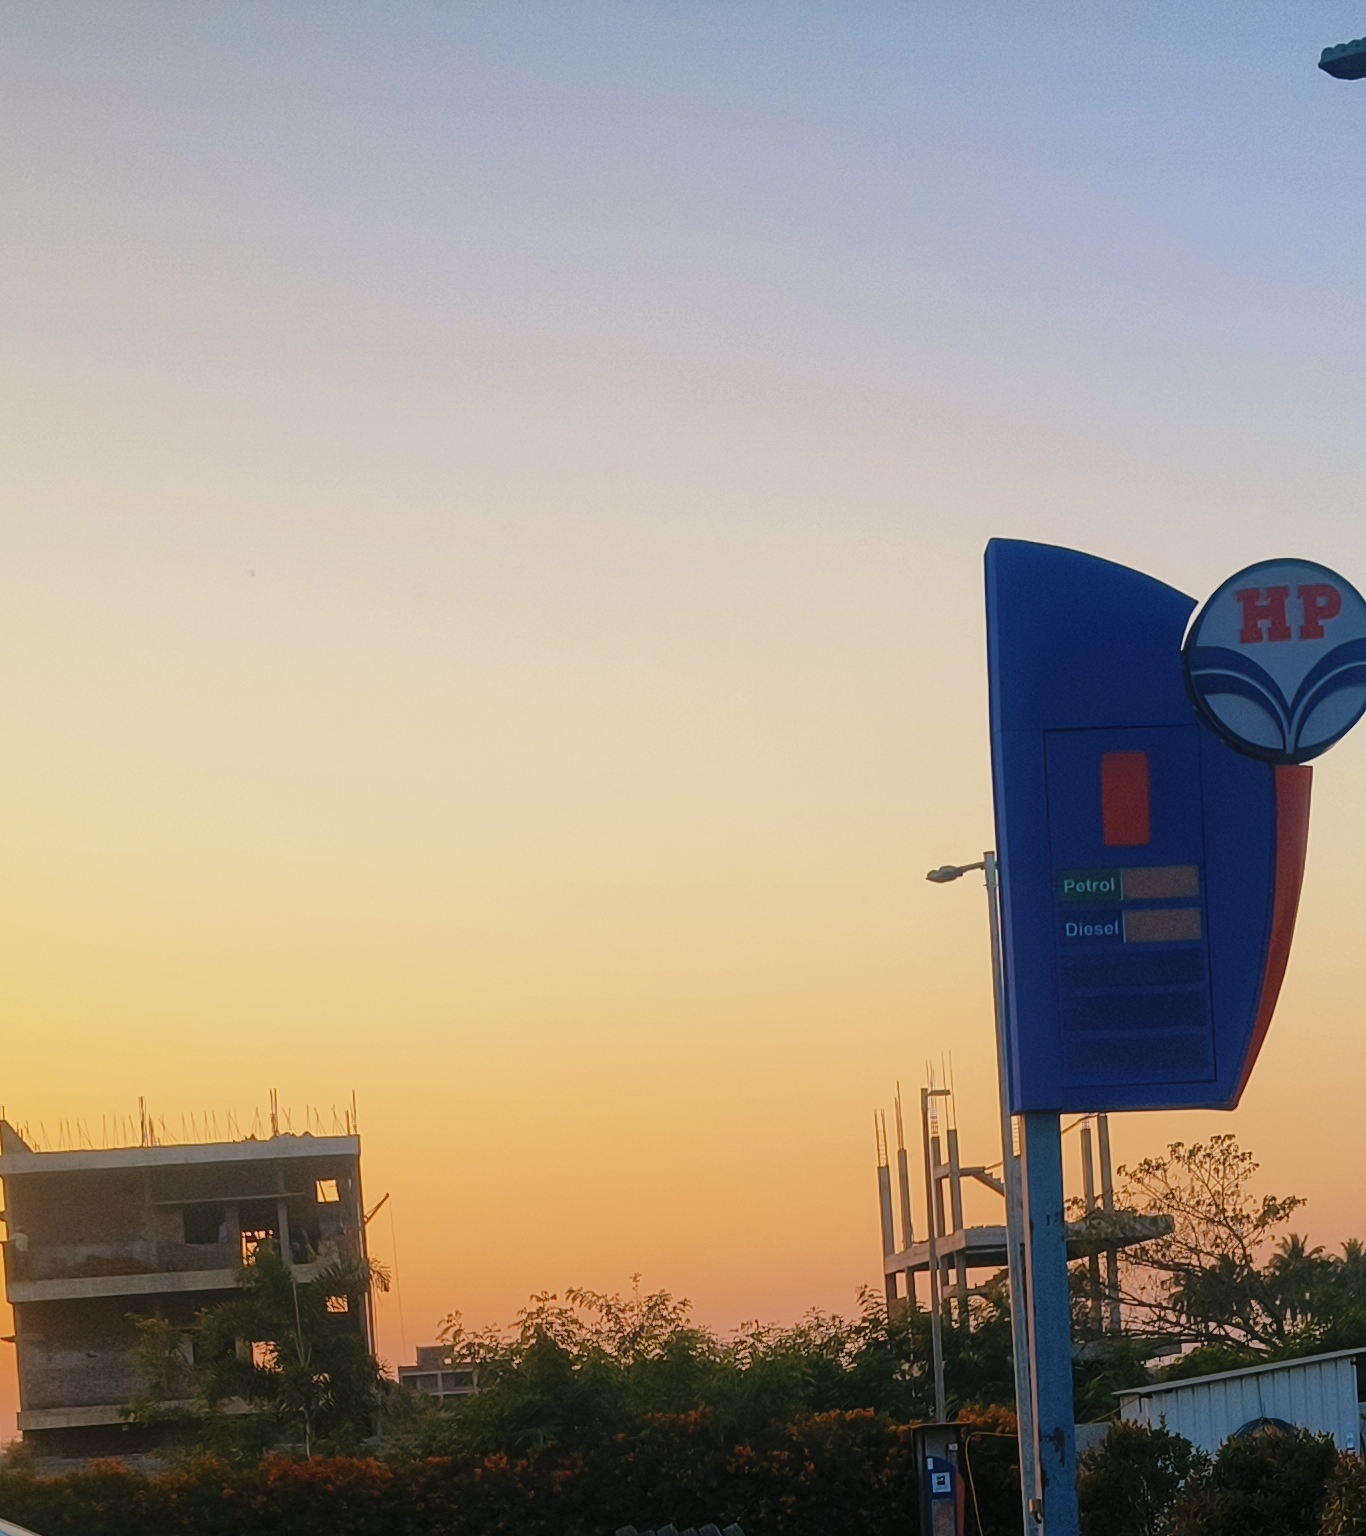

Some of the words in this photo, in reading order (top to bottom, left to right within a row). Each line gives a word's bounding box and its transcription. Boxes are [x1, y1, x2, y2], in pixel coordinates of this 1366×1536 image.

[1237, 583, 1342, 644] HP
[1064, 877, 1115, 893] Petrol
[1066, 920, 1119, 936] Diesel
